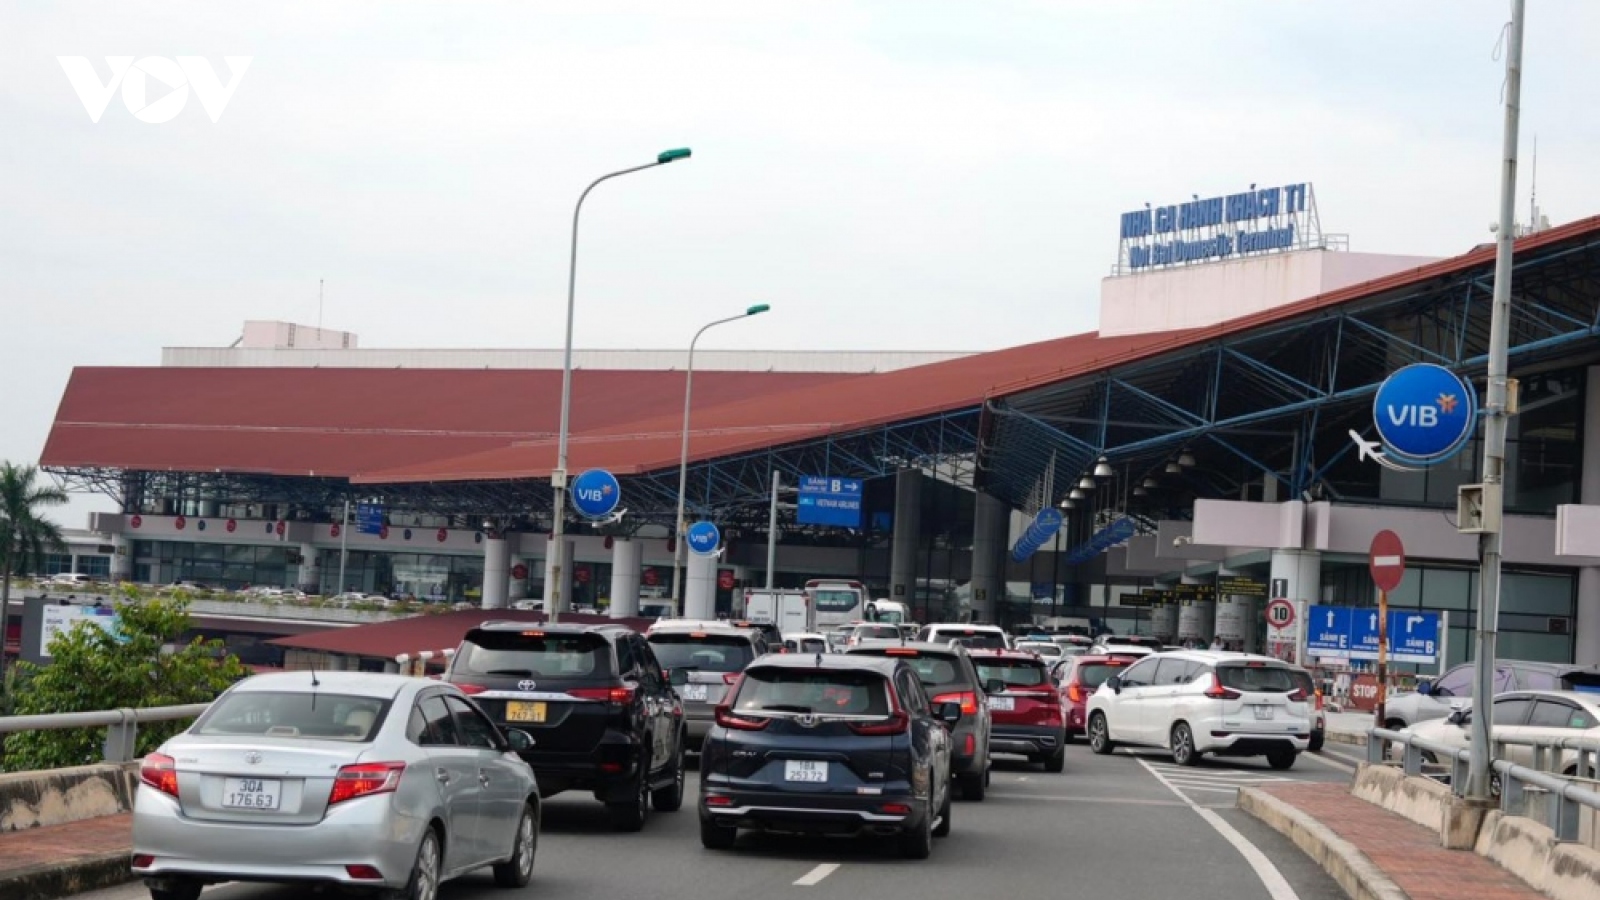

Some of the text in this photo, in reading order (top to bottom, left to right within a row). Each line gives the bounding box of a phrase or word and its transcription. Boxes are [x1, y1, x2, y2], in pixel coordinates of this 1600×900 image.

[1155, 205, 1177, 233] GA
[1285, 183, 1306, 213] T1
[1174, 233, 1234, 263] Domestic
[1236, 224, 1294, 254] Terminal
[1387, 403, 1438, 428] VIB
[831, 479, 841, 492] B
[578, 487, 603, 502] VIB
[690, 533, 708, 544] VIB
[1273, 607, 1287, 621] 10
[1339, 634, 1348, 649] E
[1425, 640, 1435, 654] B
[1353, 684, 1378, 699] STOP
[239, 779, 263, 793] 30A
[230, 792, 273, 807] 176.63
